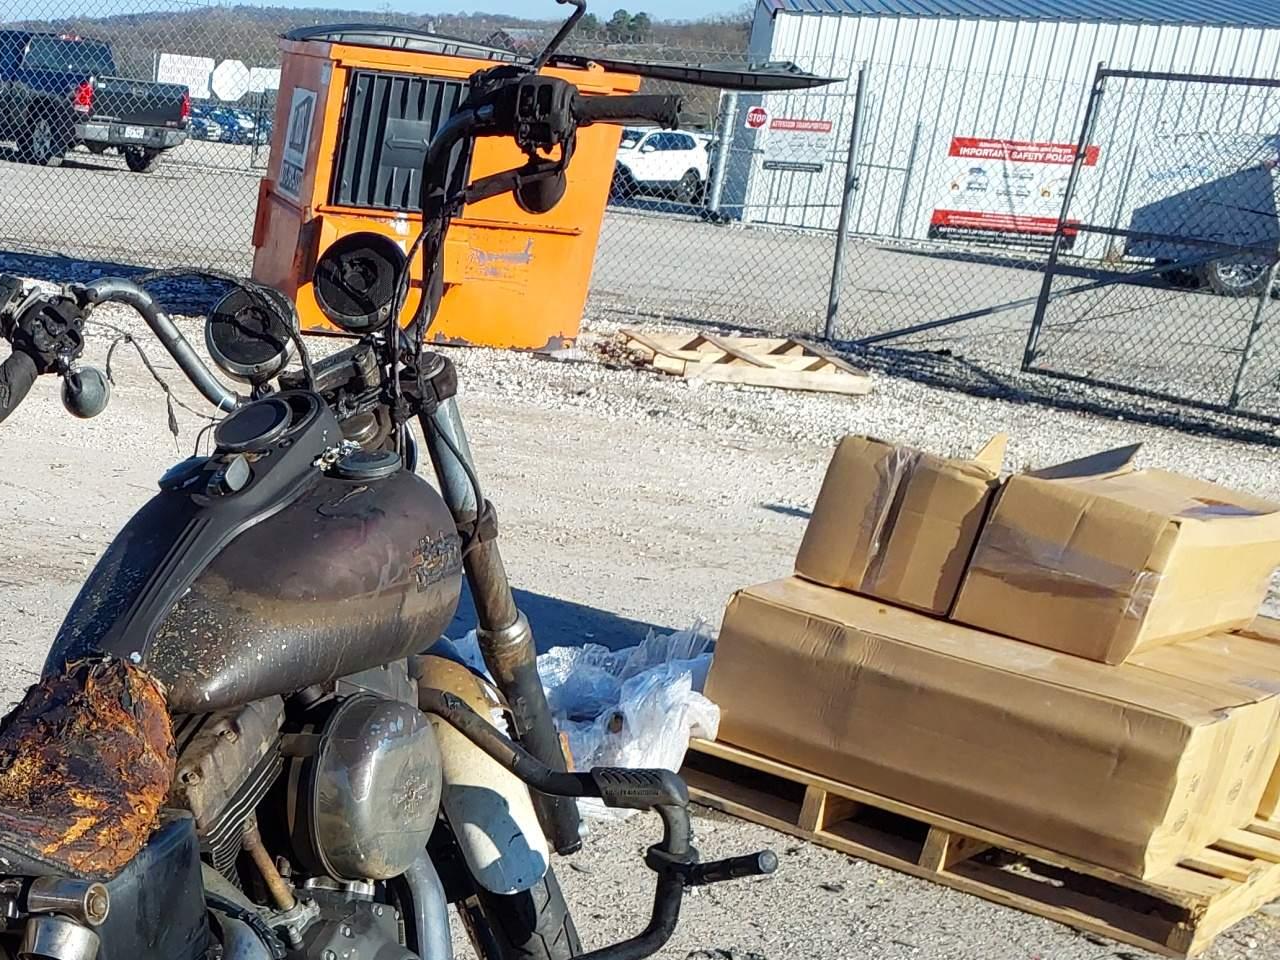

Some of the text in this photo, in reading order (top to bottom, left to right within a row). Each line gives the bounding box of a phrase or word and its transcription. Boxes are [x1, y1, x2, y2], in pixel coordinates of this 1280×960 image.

[748, 113, 767, 123] STOP
[959, 148, 1010, 159] IMPORTANT
[1011, 151, 1045, 161] SAFETY
